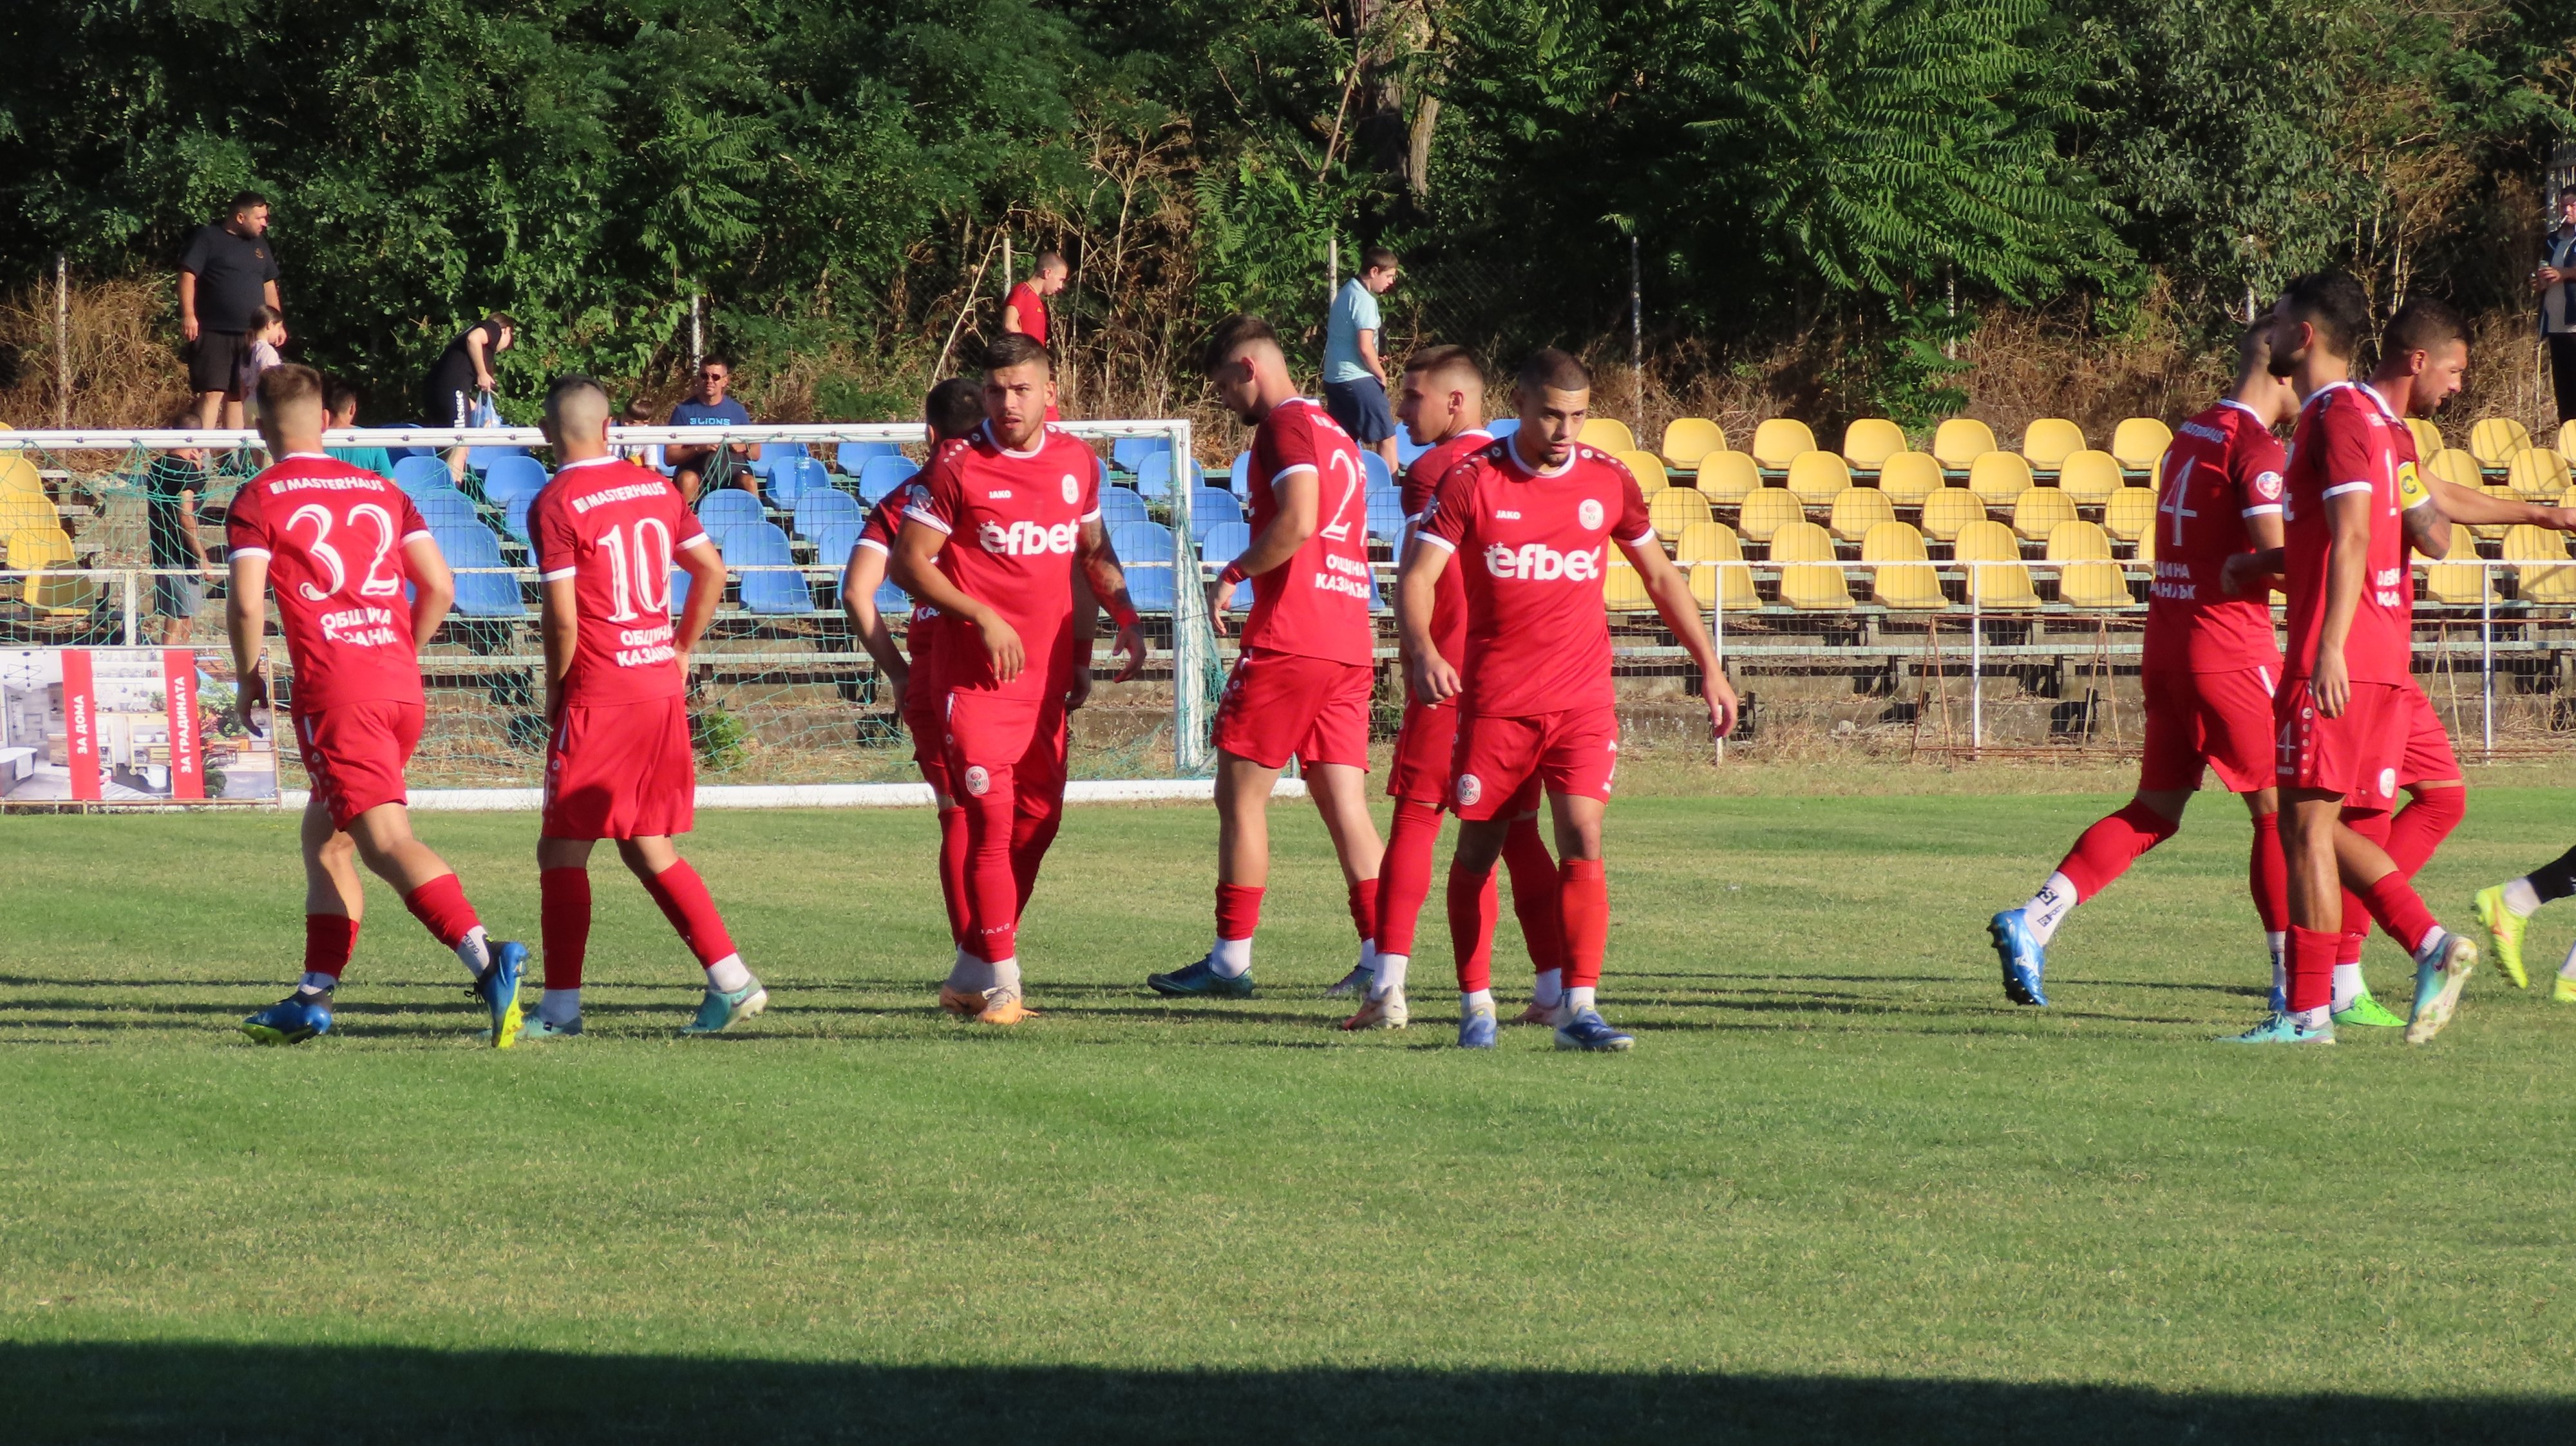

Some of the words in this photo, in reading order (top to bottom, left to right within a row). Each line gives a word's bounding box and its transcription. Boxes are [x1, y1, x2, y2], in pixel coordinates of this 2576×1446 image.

[287, 476, 385, 492] MASTERHAUS
[585, 482, 667, 507] MASTERHAUS
[989, 490, 1012, 499] JAKO
[2401, 475, 2418, 494] C
[1495, 510, 1521, 520] JAKO
[978, 519, 1079, 556] efbet
[285, 503, 399, 601] 32
[597, 517, 672, 622] 10
[73, 695, 88, 735] ДОМА
[174, 676, 191, 753] ГРАДИНАТА
[77, 736, 88, 755] ЗА
[180, 755, 192, 773] ЗА
